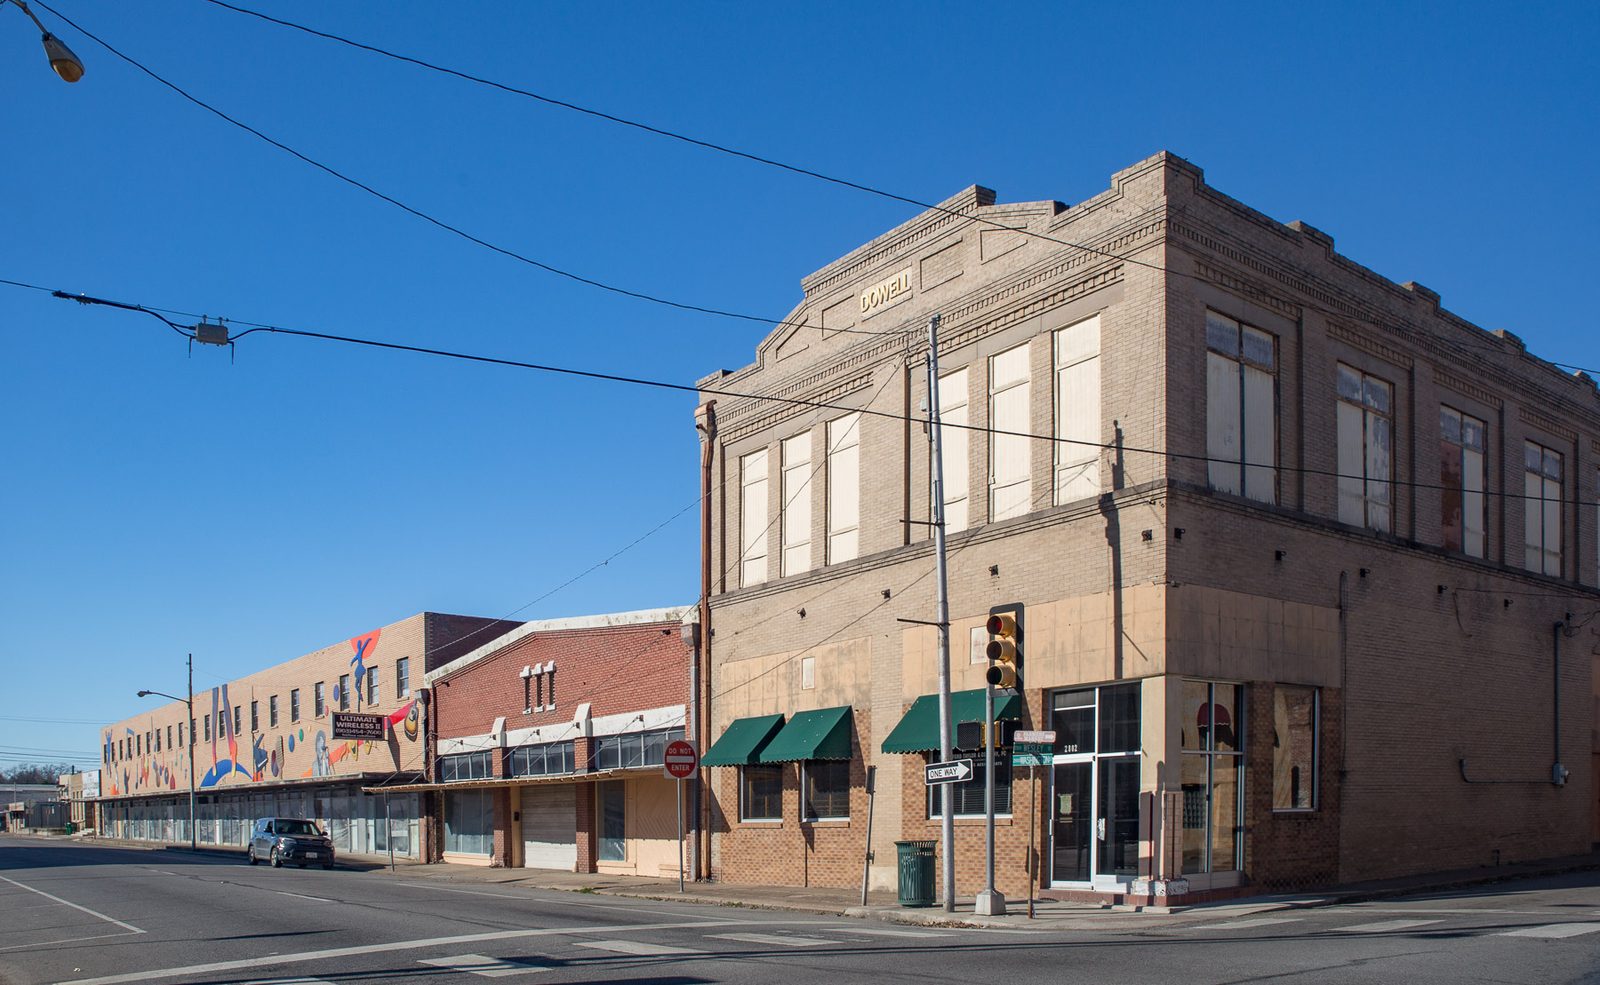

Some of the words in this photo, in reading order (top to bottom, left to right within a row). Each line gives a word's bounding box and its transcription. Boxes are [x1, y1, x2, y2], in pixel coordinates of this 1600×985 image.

[861, 271, 911, 313] DOWELL
[340, 715, 377, 723] ULTIMATE
[336, 721, 374, 729] WIRELESS
[930, 769, 943, 778] ONE
[944, 767, 957, 776] WAY
